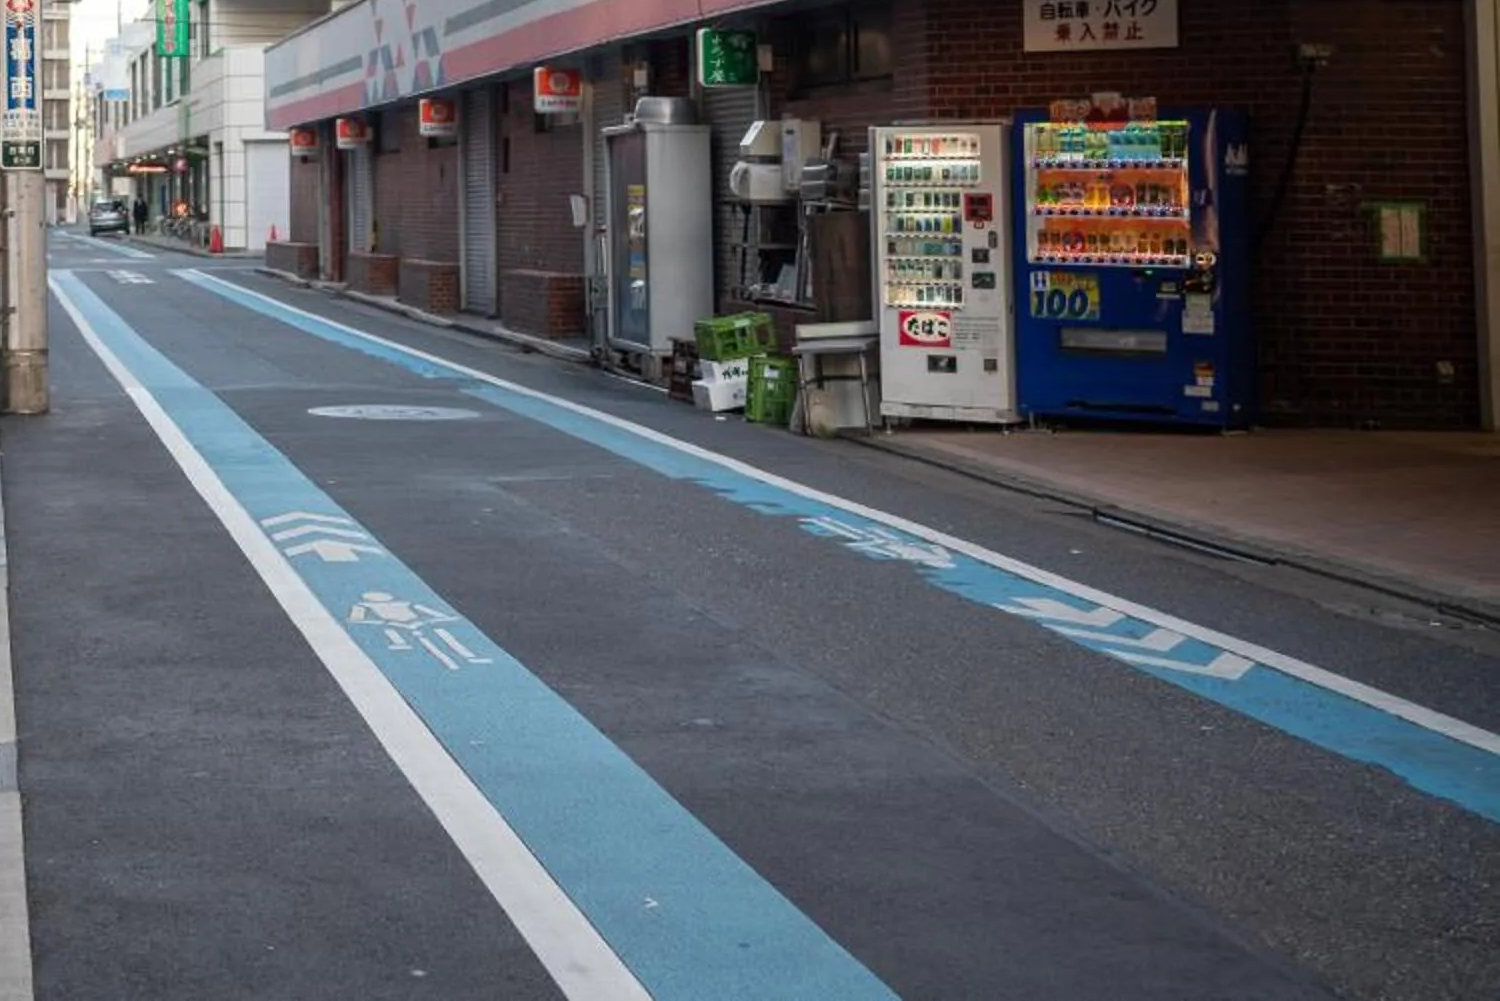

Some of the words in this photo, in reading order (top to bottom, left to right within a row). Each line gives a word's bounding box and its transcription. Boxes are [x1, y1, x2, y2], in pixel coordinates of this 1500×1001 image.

[1055, 21, 1144, 44] 乗入禁止
[907, 317, 948, 338] たばこ
